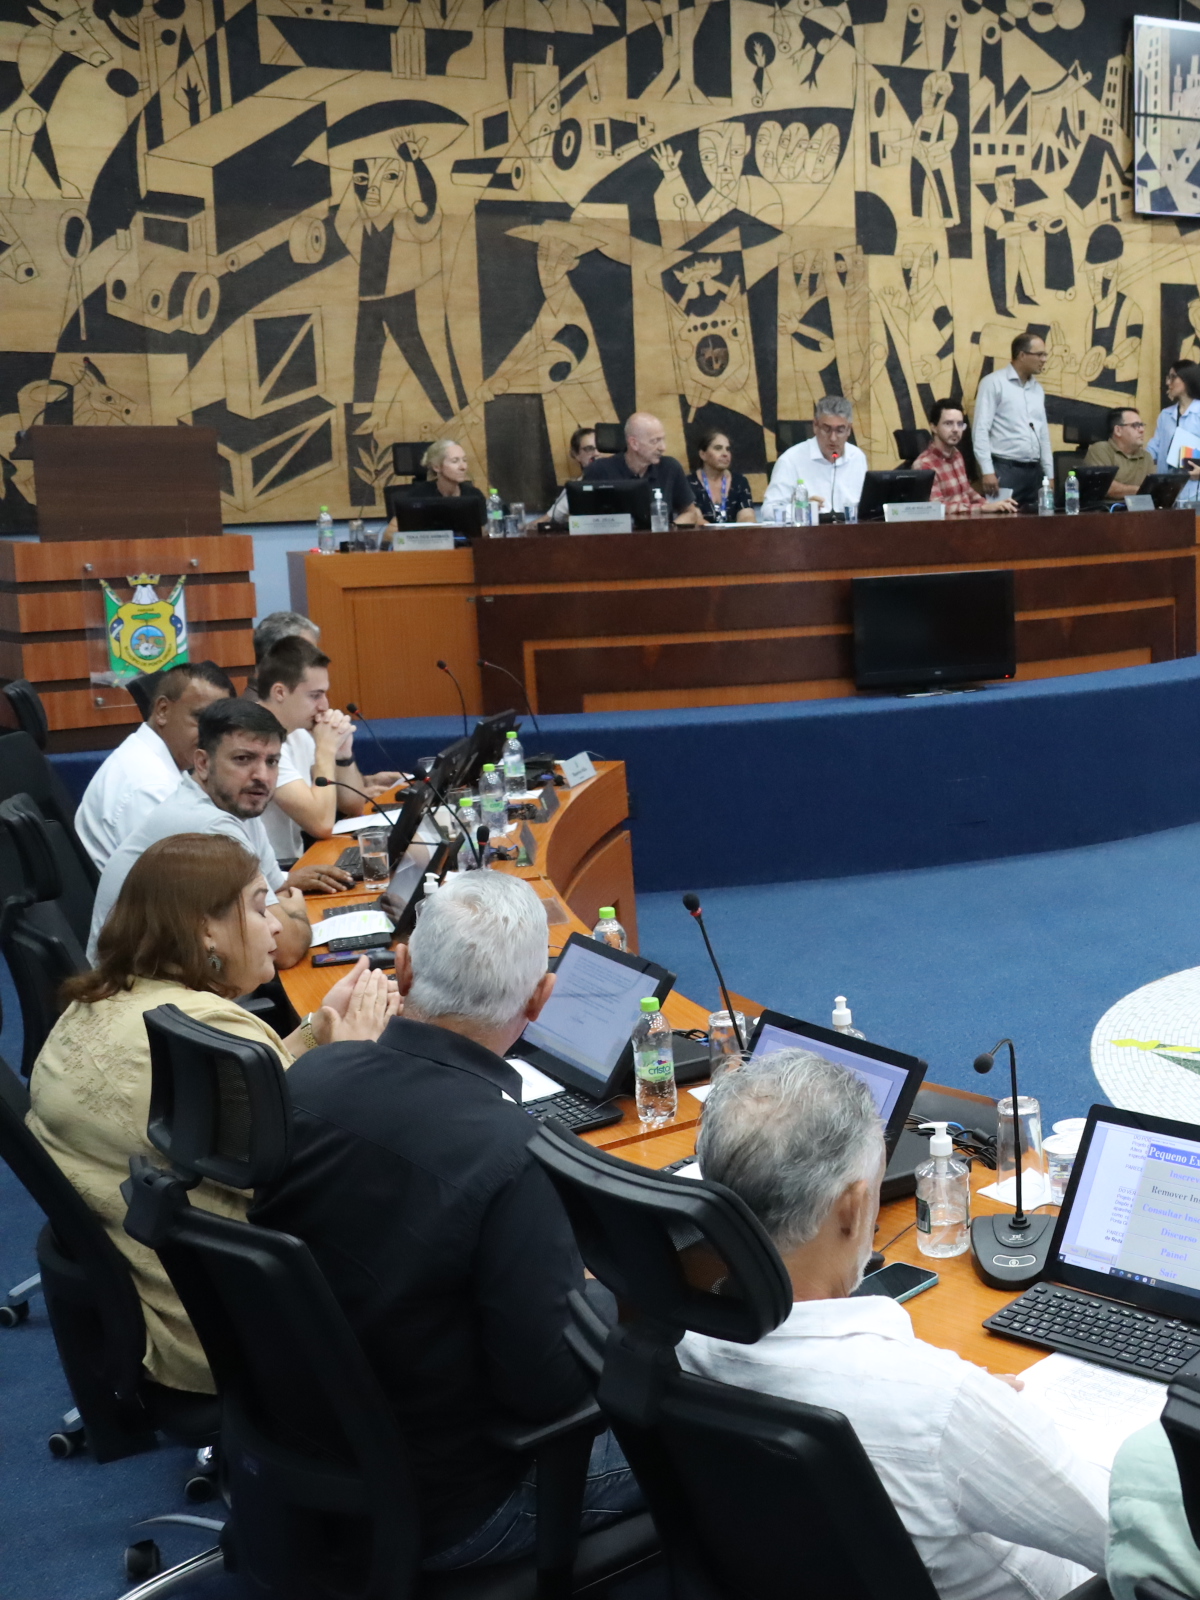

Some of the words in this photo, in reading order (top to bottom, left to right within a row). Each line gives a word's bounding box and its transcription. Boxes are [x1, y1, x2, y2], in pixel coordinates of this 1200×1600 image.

[1148, 1146, 1187, 1166] Pequeno
[1151, 1185, 1188, 1202] Remover
[1142, 1202, 1183, 1221] Consultar
[1160, 1226, 1198, 1245] Discurso
[1160, 1246, 1188, 1263] Painel
[1159, 1267, 1178, 1281] Sair
